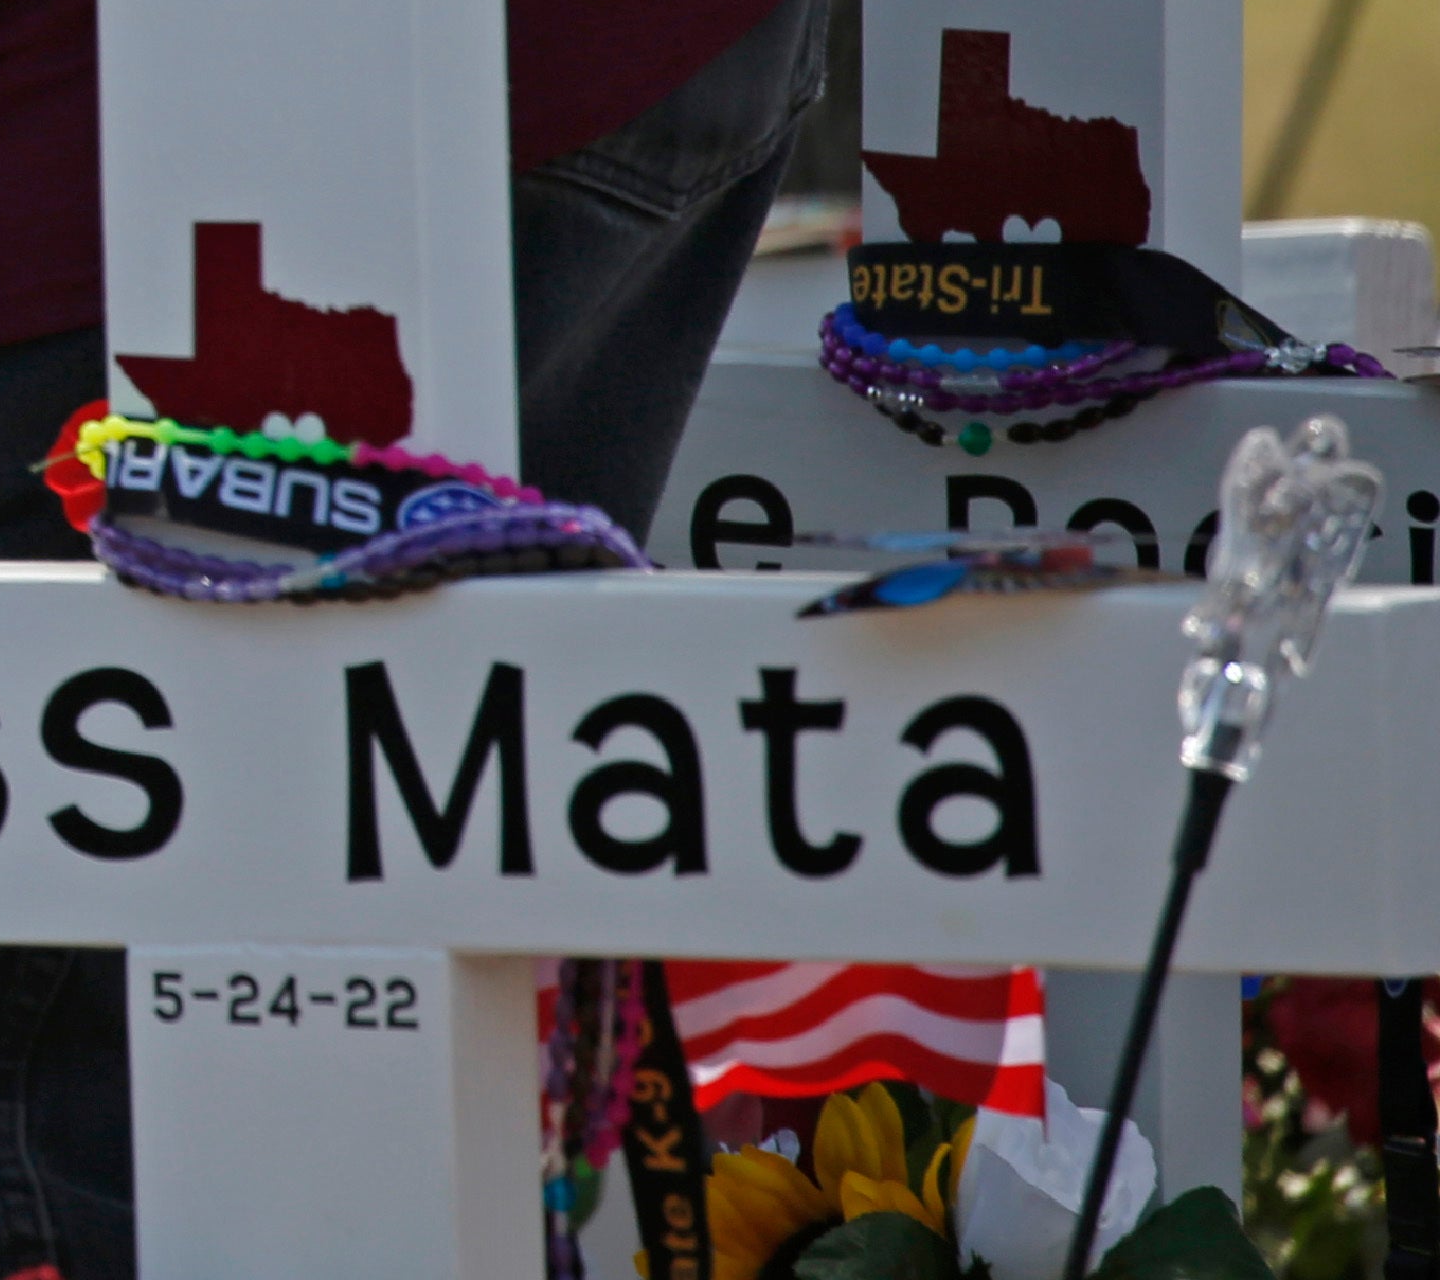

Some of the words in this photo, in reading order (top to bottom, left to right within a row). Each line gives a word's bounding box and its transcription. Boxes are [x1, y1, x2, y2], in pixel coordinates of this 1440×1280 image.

[852, 265, 1051, 314] Tri-State
[345, 661, 1042, 881] Mata
[153, 972, 419, 1030] 5-24-22
